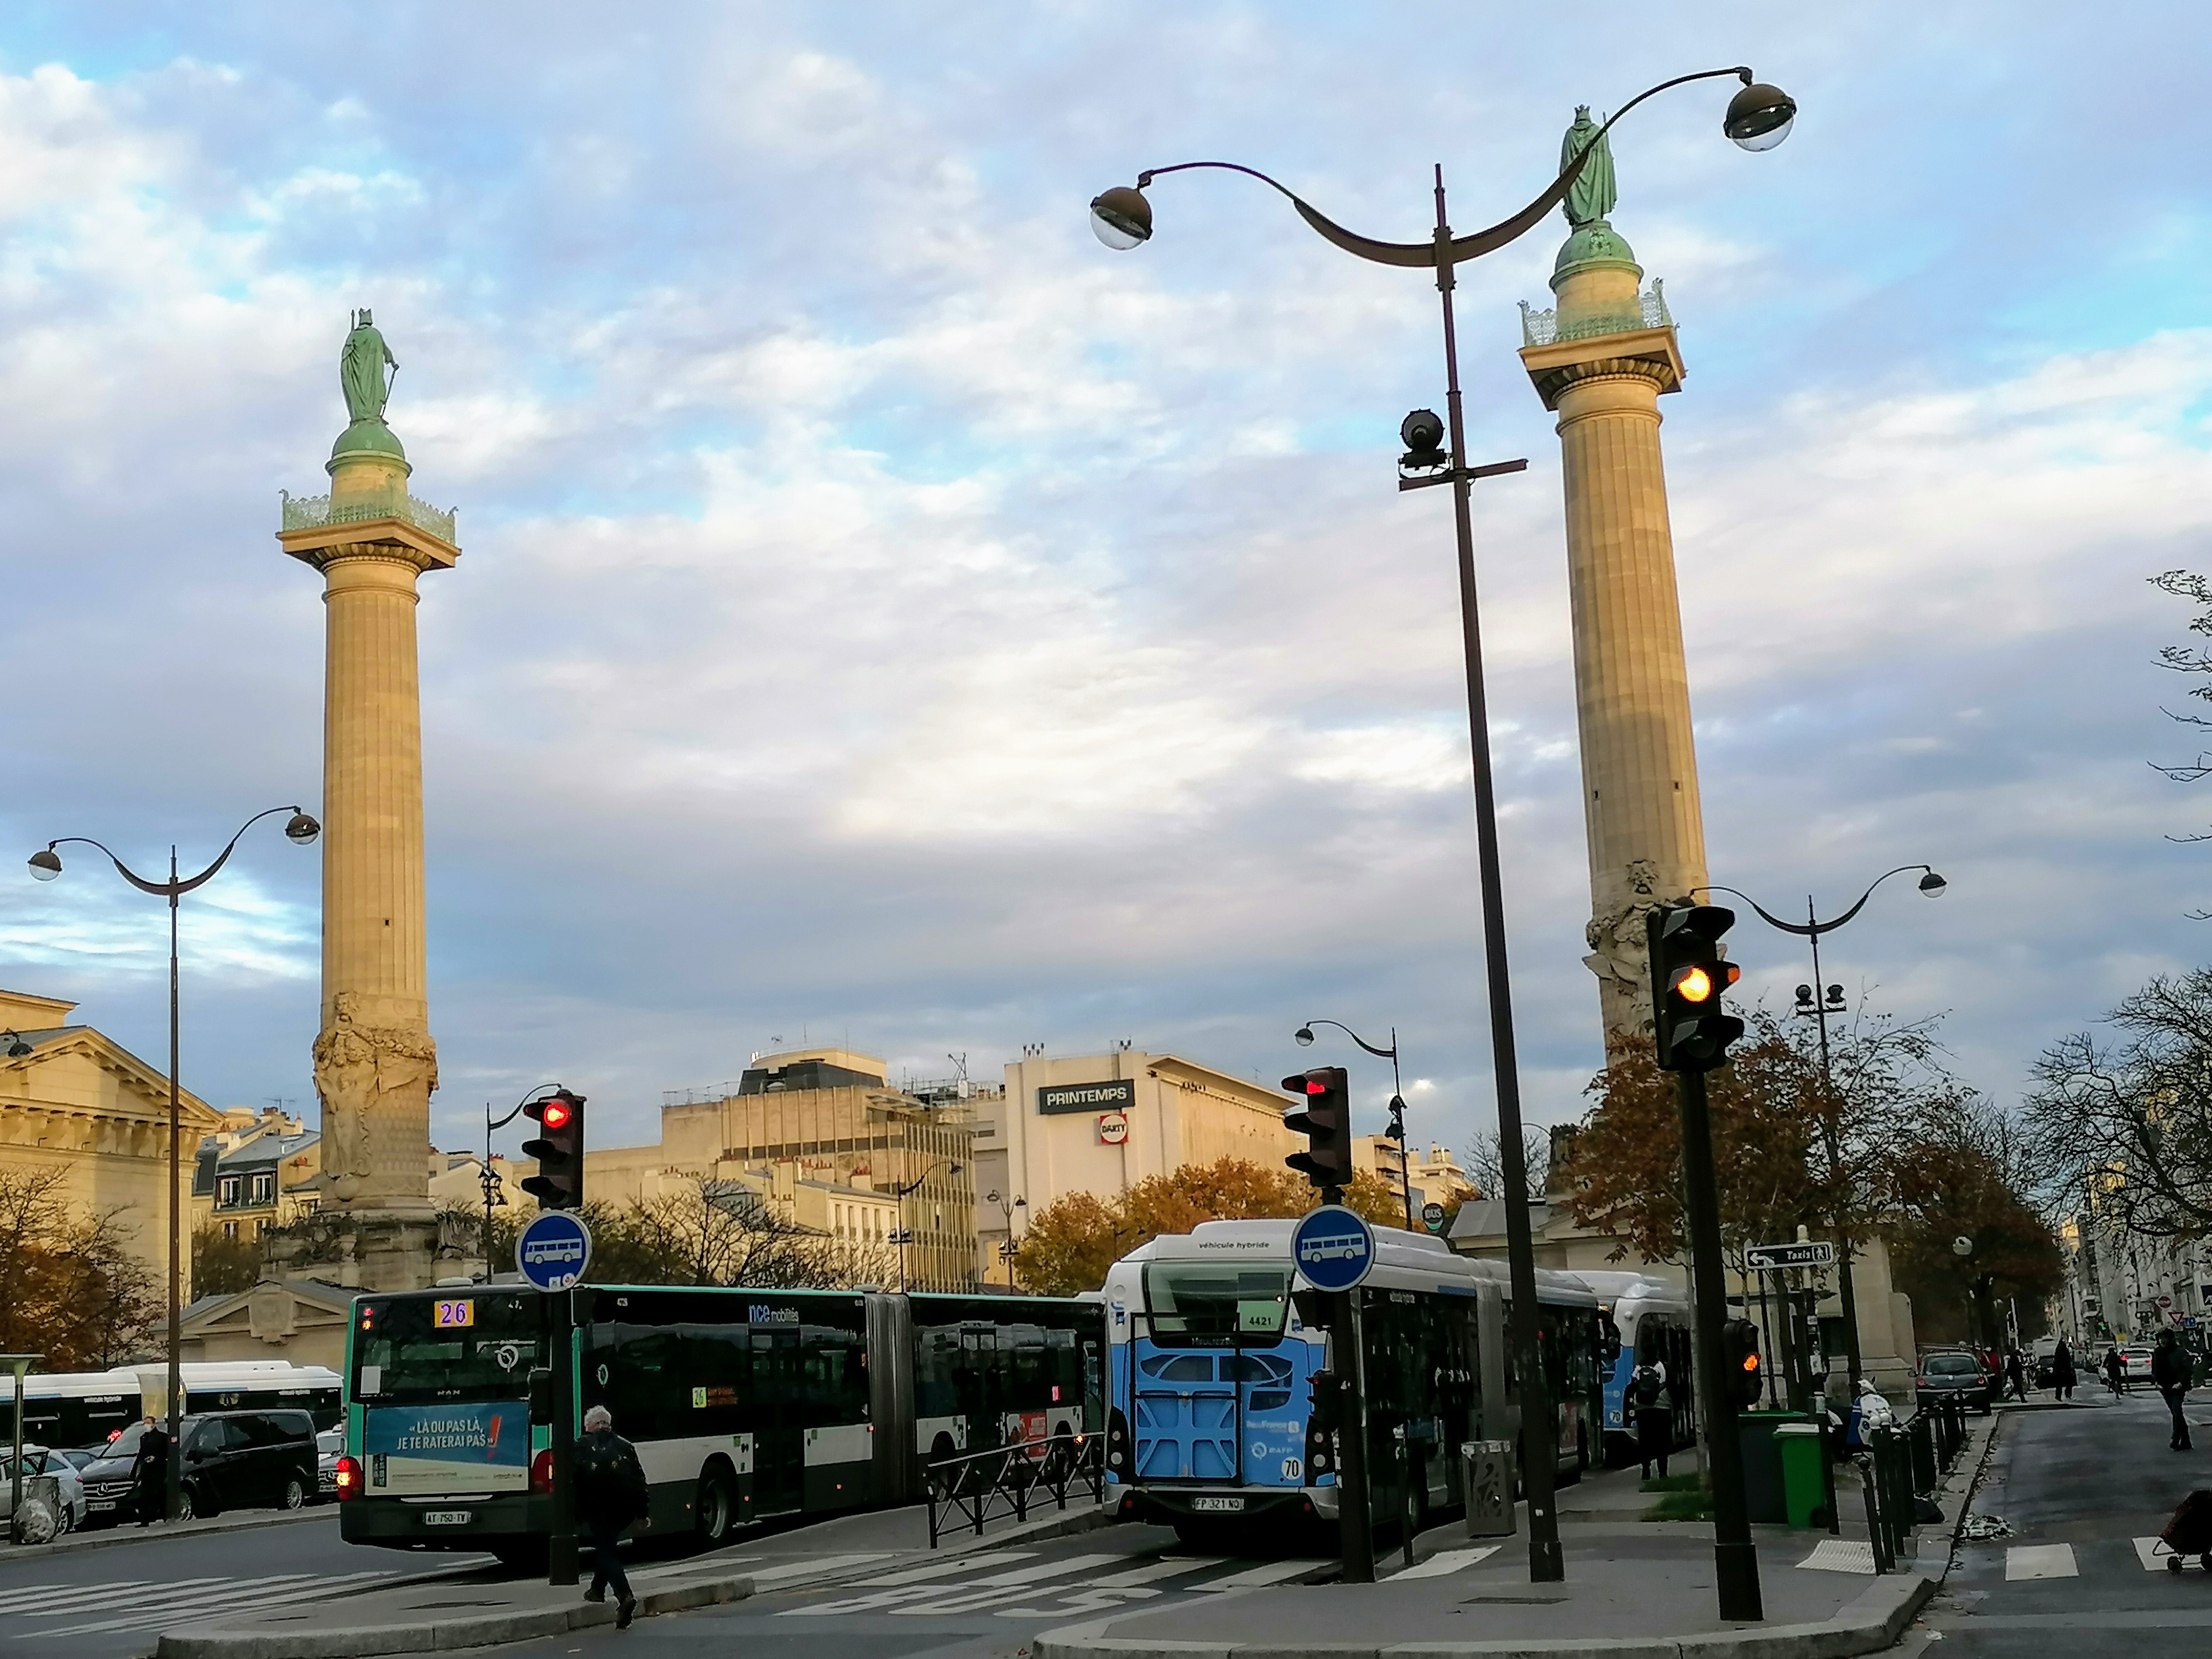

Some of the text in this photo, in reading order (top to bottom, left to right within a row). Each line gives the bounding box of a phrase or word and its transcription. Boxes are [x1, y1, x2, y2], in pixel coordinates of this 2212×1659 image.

[1047, 1087, 1127, 1106] PRINTEMPS
[1425, 1208, 1442, 1219] BUS
[1787, 1250, 1811, 1260] Taxis
[441, 1303, 466, 1323] 26
[1249, 1317, 1271, 1326] 4421
[1612, 1412, 1621, 1422] 70
[431, 1420, 445, 1433] OU
[446, 1420, 466, 1432] PAS
[397, 1437, 408, 1450] JE
[410, 1437, 421, 1449] TE
[423, 1434, 465, 1449] RATERAI
[467, 1434, 486, 1447] PAS
[1285, 1460, 1299, 1477] 70
